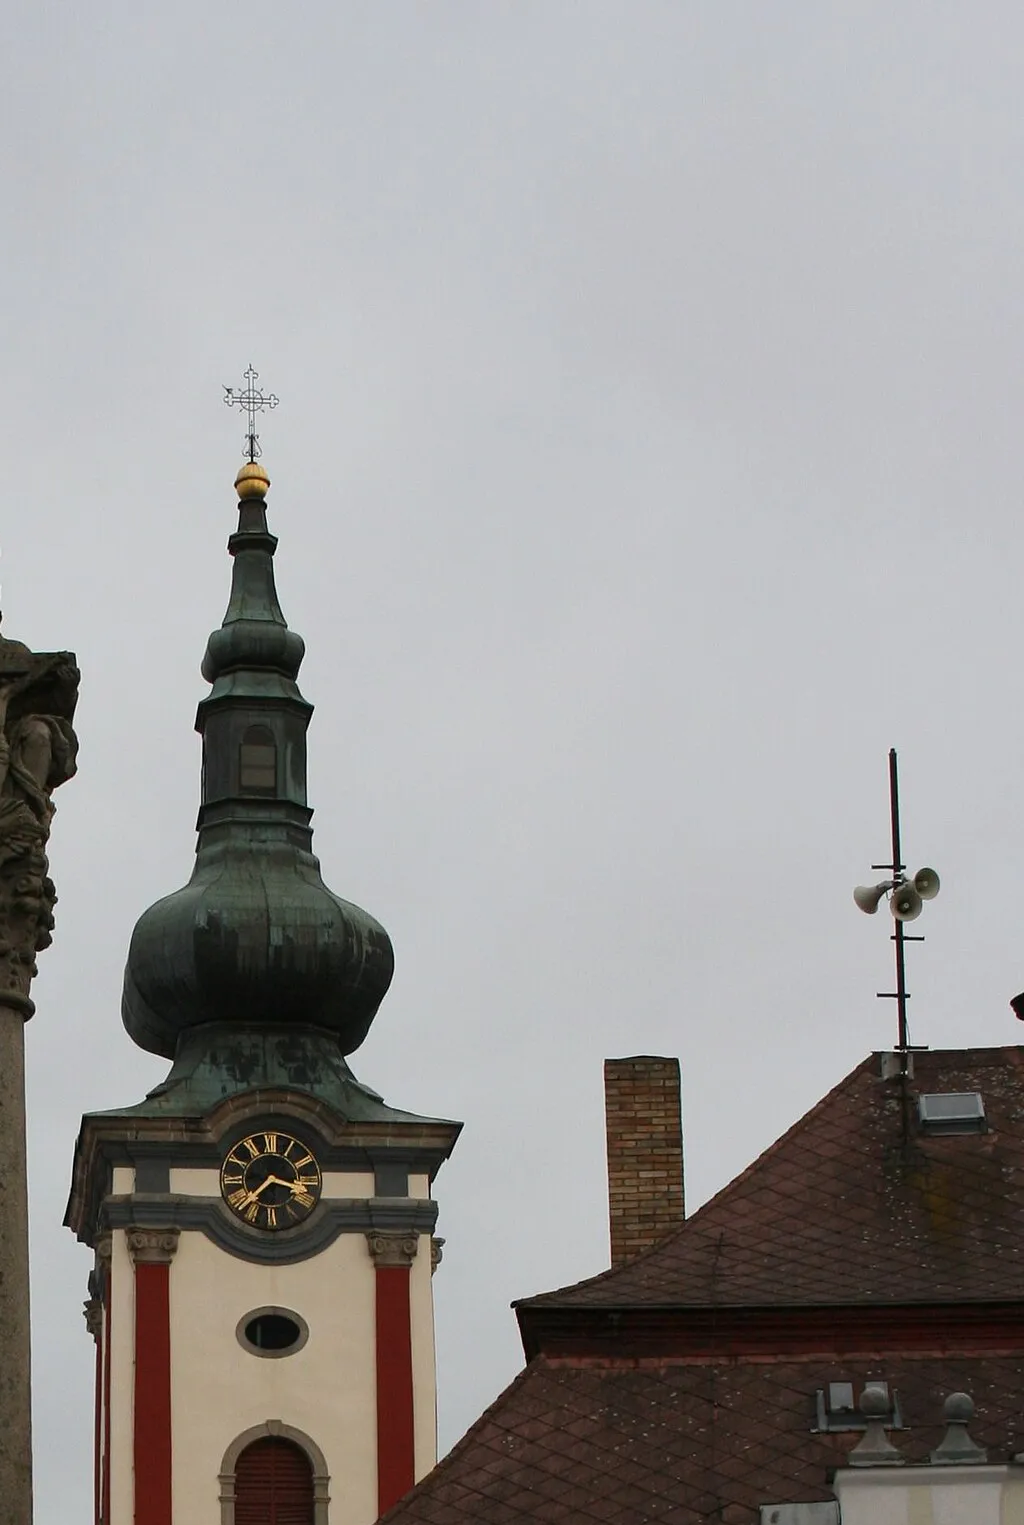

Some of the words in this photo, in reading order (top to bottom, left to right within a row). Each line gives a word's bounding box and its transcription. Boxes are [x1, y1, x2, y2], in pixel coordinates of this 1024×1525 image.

[243, 1139, 260, 1158] XI
[264, 1135, 277, 1153] XII
[284, 1141, 295, 1157] I
[229, 1154, 247, 1168] X
[295, 1155, 313, 1169] II
[224, 1174, 243, 1185] IX
[267, 1207, 277, 1226] VI
